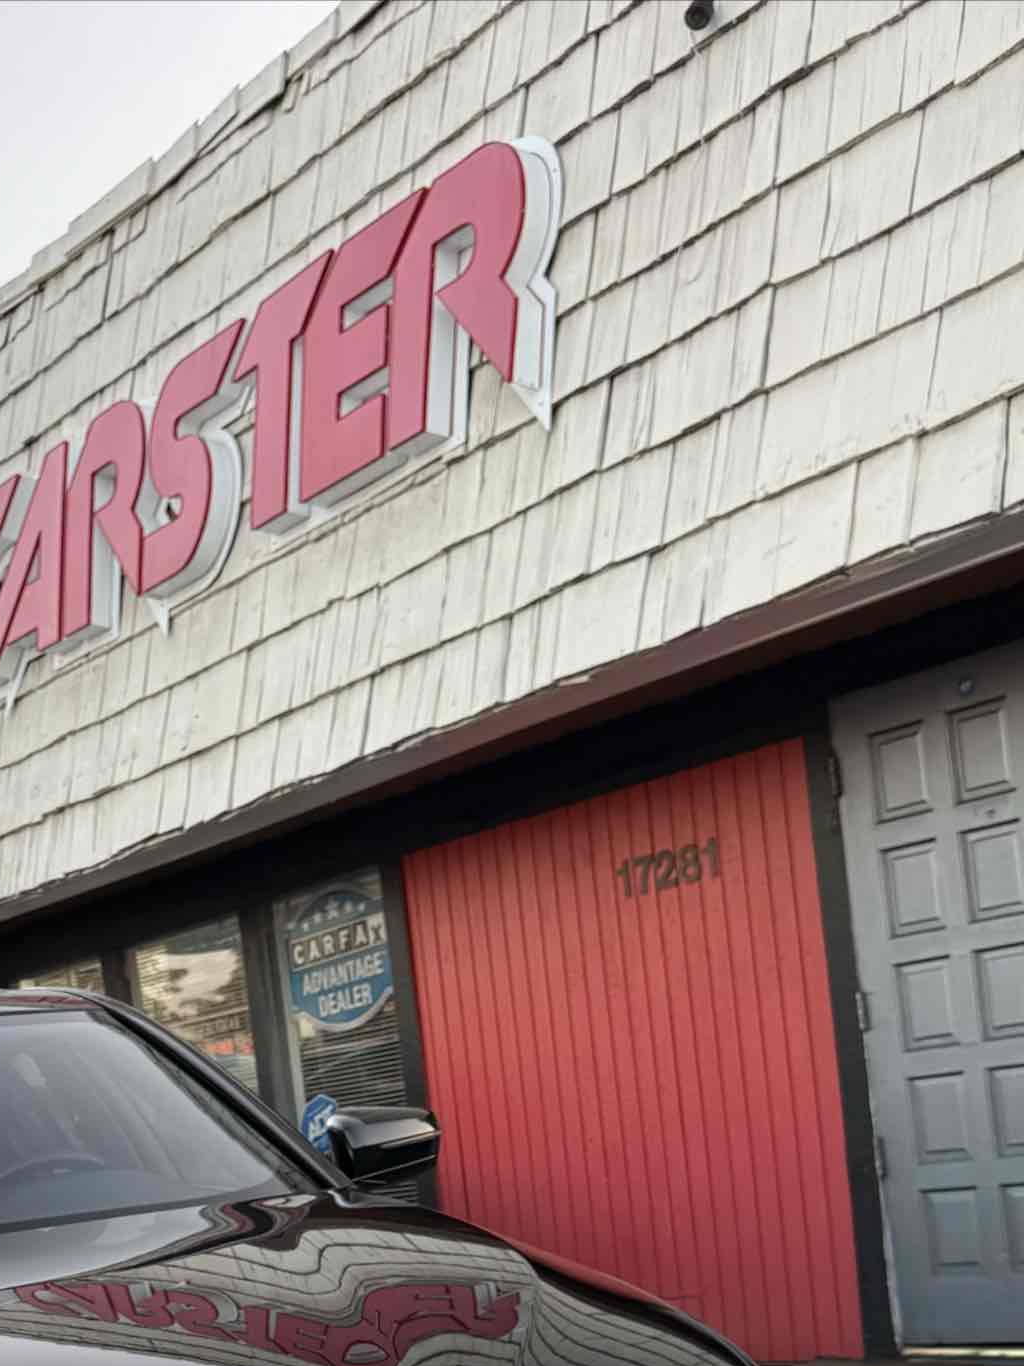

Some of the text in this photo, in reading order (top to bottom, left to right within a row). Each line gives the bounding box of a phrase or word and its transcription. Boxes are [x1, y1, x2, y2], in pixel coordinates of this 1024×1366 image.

[616, 837, 720, 898] 17281
[292, 919, 387, 965] CARFAX
[302, 950, 385, 996] ADVANTAGE
[318, 983, 373, 1017] DEALER
